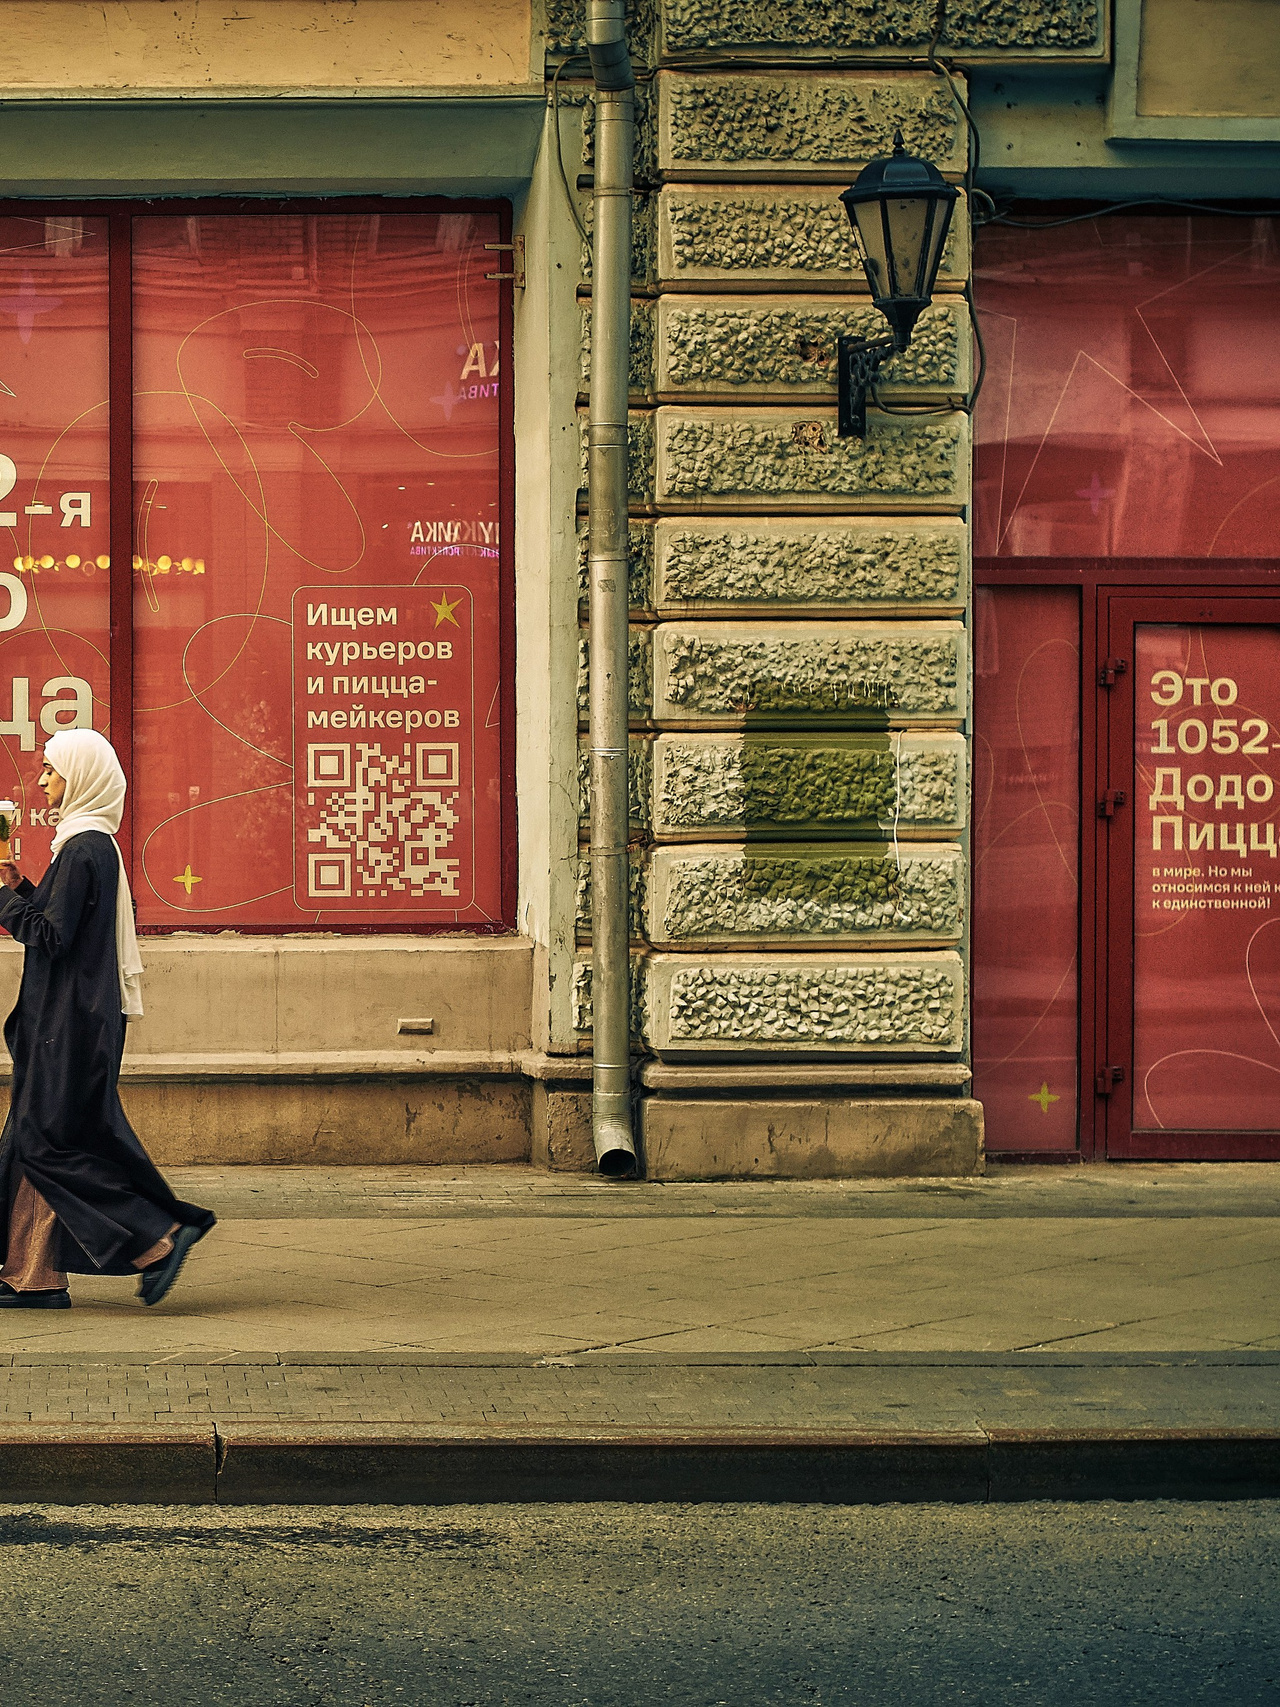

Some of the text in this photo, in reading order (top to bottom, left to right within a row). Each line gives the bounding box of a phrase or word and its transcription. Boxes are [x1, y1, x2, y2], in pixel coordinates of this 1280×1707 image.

[307, 603, 398, 630] Ищем
[307, 641, 453, 666] курьеров
[307, 675, 439, 699] и пицца-
[1150, 670, 1238, 706] Это
[307, 704, 460, 734] мейкеров
[1149, 767, 1274, 811] Додо
[1152, 815, 1280, 858] Пицц
[1152, 865, 1253, 881] в мире. Но мы
[1152, 883, 1231, 894] относимся
[1234, 883, 1242, 894] к
[1245, 880, 1271, 894] ней
[1152, 896, 1271, 911] к единственной!
